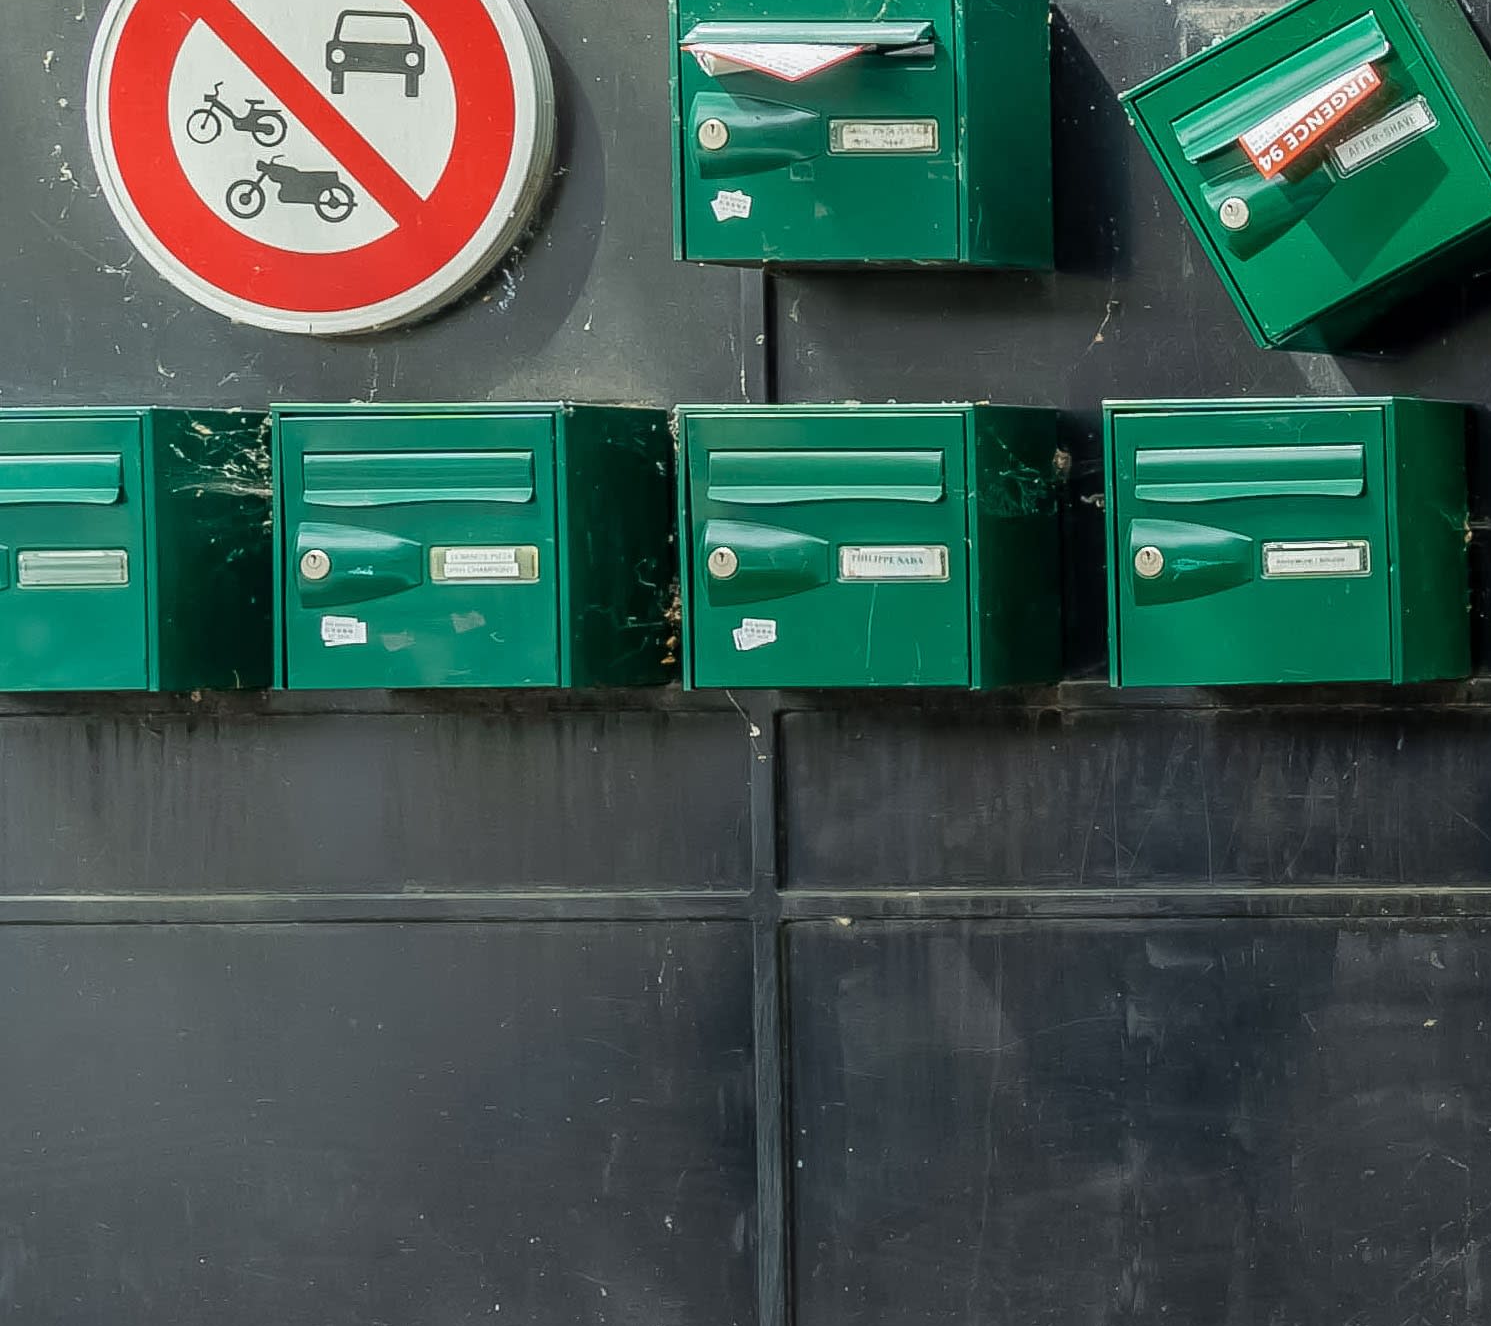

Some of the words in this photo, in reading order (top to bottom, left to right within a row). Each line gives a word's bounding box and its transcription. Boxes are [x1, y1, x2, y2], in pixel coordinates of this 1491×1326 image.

[1287, 68, 1378, 150] URGENCE
[1258, 146, 1285, 172] 94
[1347, 115, 1420, 161] AFTER-SHAVE
